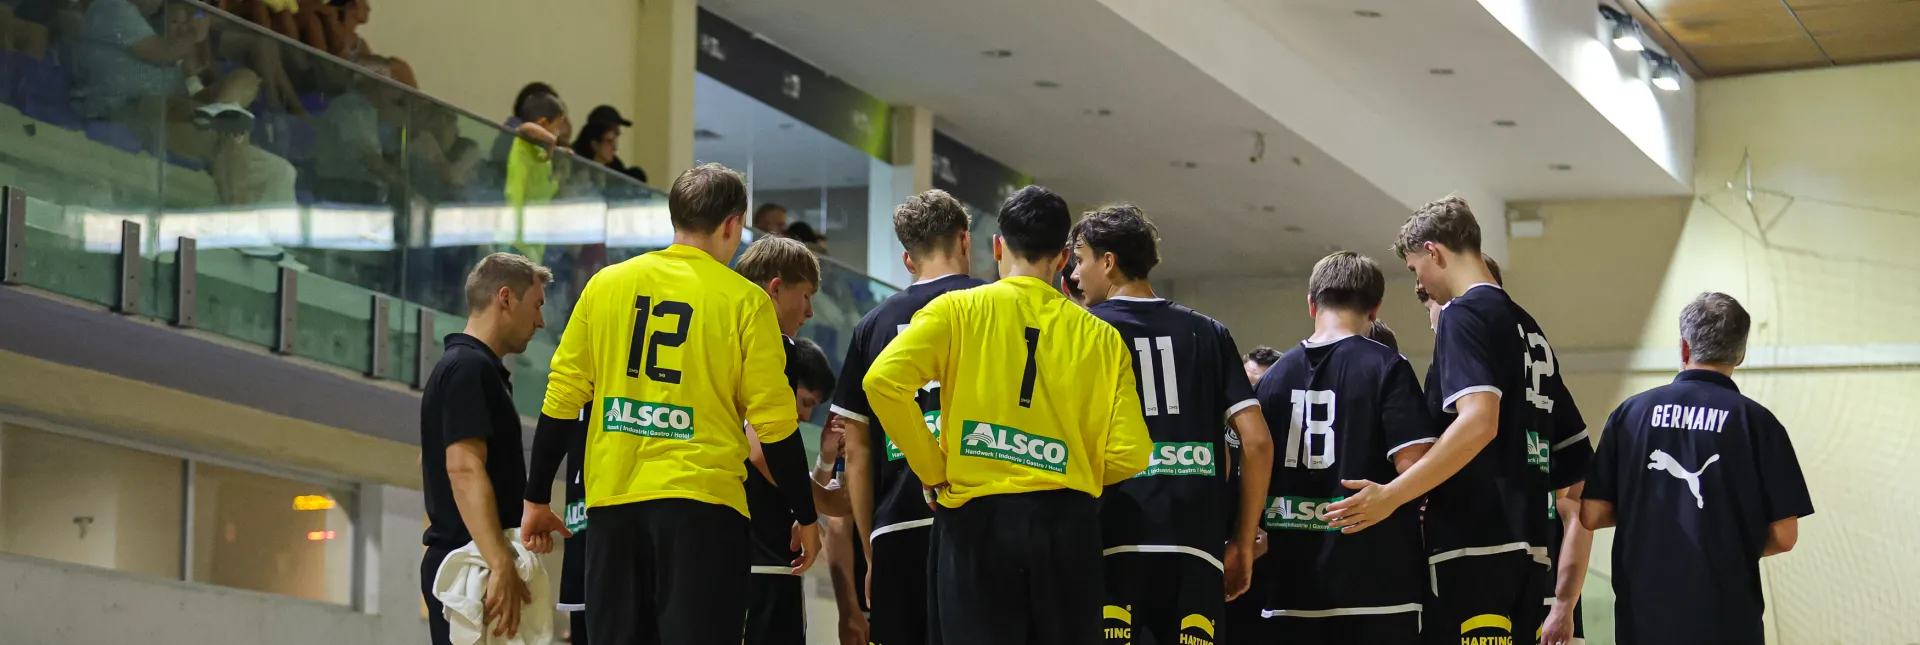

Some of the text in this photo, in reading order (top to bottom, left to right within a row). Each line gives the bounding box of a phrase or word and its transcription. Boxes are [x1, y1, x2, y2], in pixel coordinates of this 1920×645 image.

[626, 295, 694, 385] 12
[1019, 326, 1041, 408] 1
[1133, 336, 1180, 416] 11
[604, 397, 691, 430] ALSCO
[1284, 389, 1336, 469] 18
[1651, 404, 1729, 433] GERMANY
[962, 423, 1066, 464] ALSCO
[1149, 445, 1212, 466] LSCO
[965, 448, 1063, 473] Handwerk Industrie Gastro Hotel
[1265, 496, 1336, 521] ALSC
[1104, 627, 1131, 639] TING
[1461, 635, 1513, 645] HARTING
